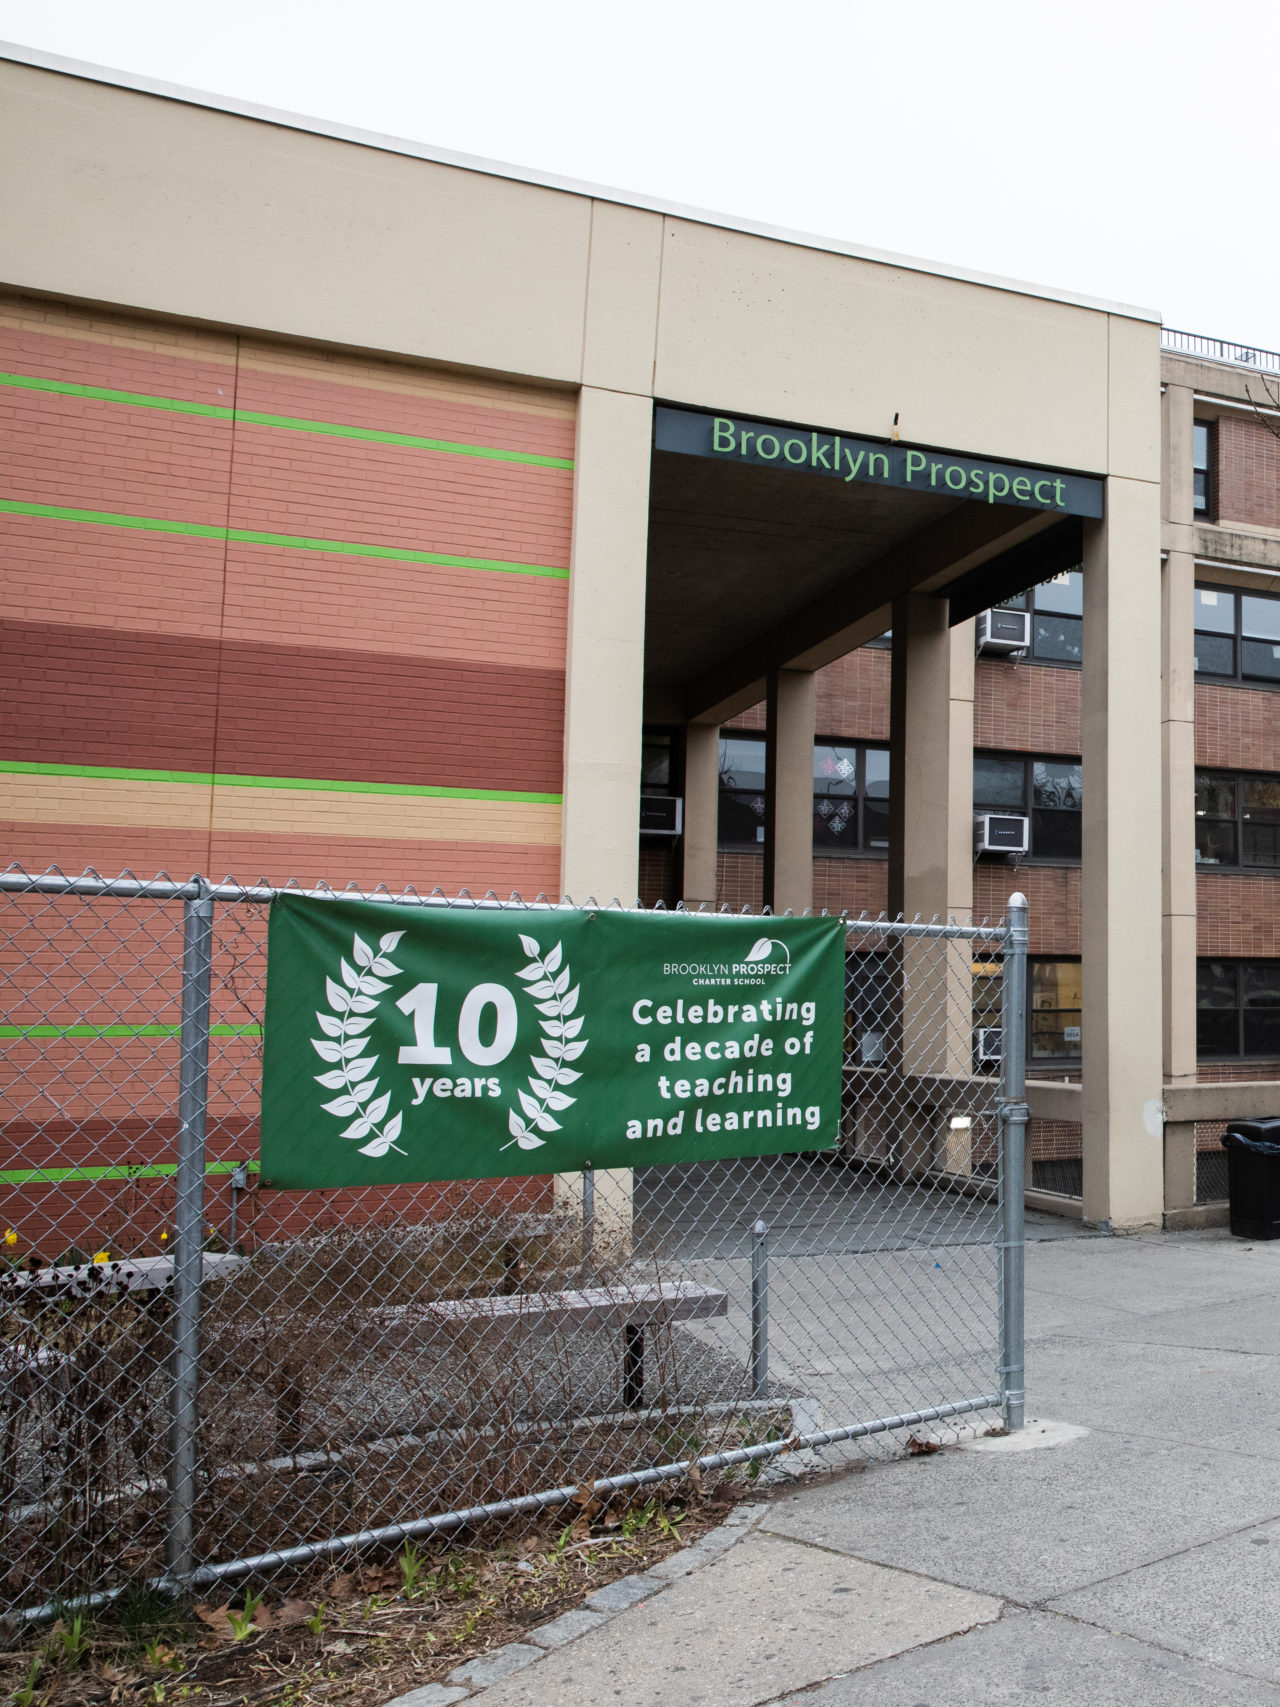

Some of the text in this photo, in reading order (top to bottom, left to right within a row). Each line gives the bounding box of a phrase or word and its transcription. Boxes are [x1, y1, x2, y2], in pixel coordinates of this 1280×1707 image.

[712, 417, 1067, 507] Brooklyn Prospect
[663, 963, 792, 975] BROOKLYN PROSPECT
[692, 978, 766, 986] CHARTER SCHOOL
[394, 982, 519, 1066] 10
[631, 996, 817, 1027] Celebrating
[634, 1030, 815, 1064] a decade of
[410, 1076, 502, 1106] years
[657, 1068, 793, 1101] teaching
[625, 1109, 685, 1141] and
[694, 1102, 822, 1135] learning
